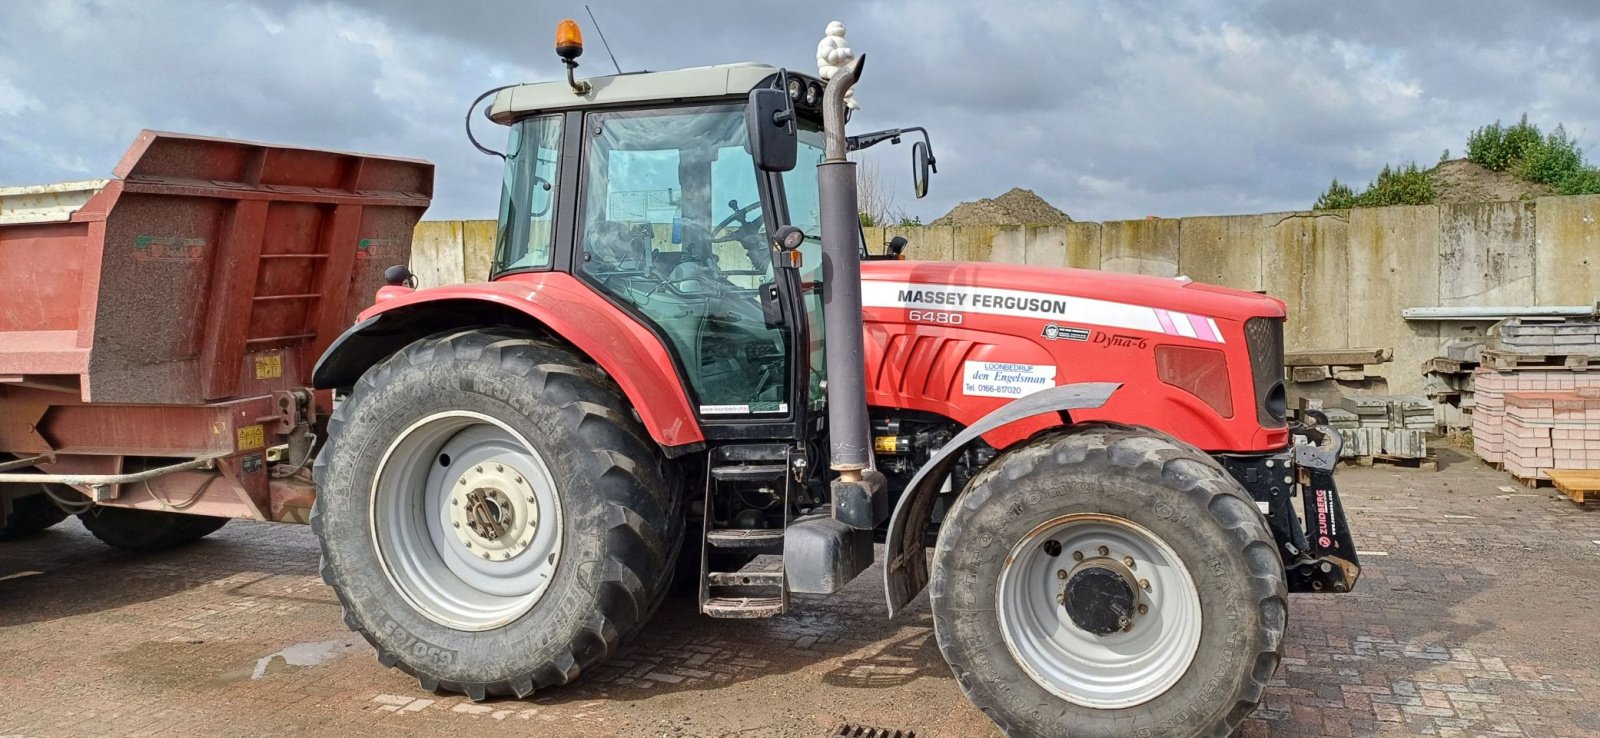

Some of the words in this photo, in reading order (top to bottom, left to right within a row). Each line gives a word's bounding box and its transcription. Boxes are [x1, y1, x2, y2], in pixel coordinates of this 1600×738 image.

[898, 289, 968, 306] MASSEY
[972, 293, 1067, 315] FERGUSON
[909, 310, 963, 325] 6480
[1092, 332, 1148, 349] Dyna-6
[984, 363, 1034, 373] LOONBEDRIJF
[972, 370, 989, 381] den
[994, 371, 1046, 384] Engelsman
[978, 384, 1022, 394] 0166-617020
[1315, 489, 1328, 535] ZUIDBERG
[1208, 558, 1238, 621] MAXI
[1158, 633, 1238, 732] TRACTION
